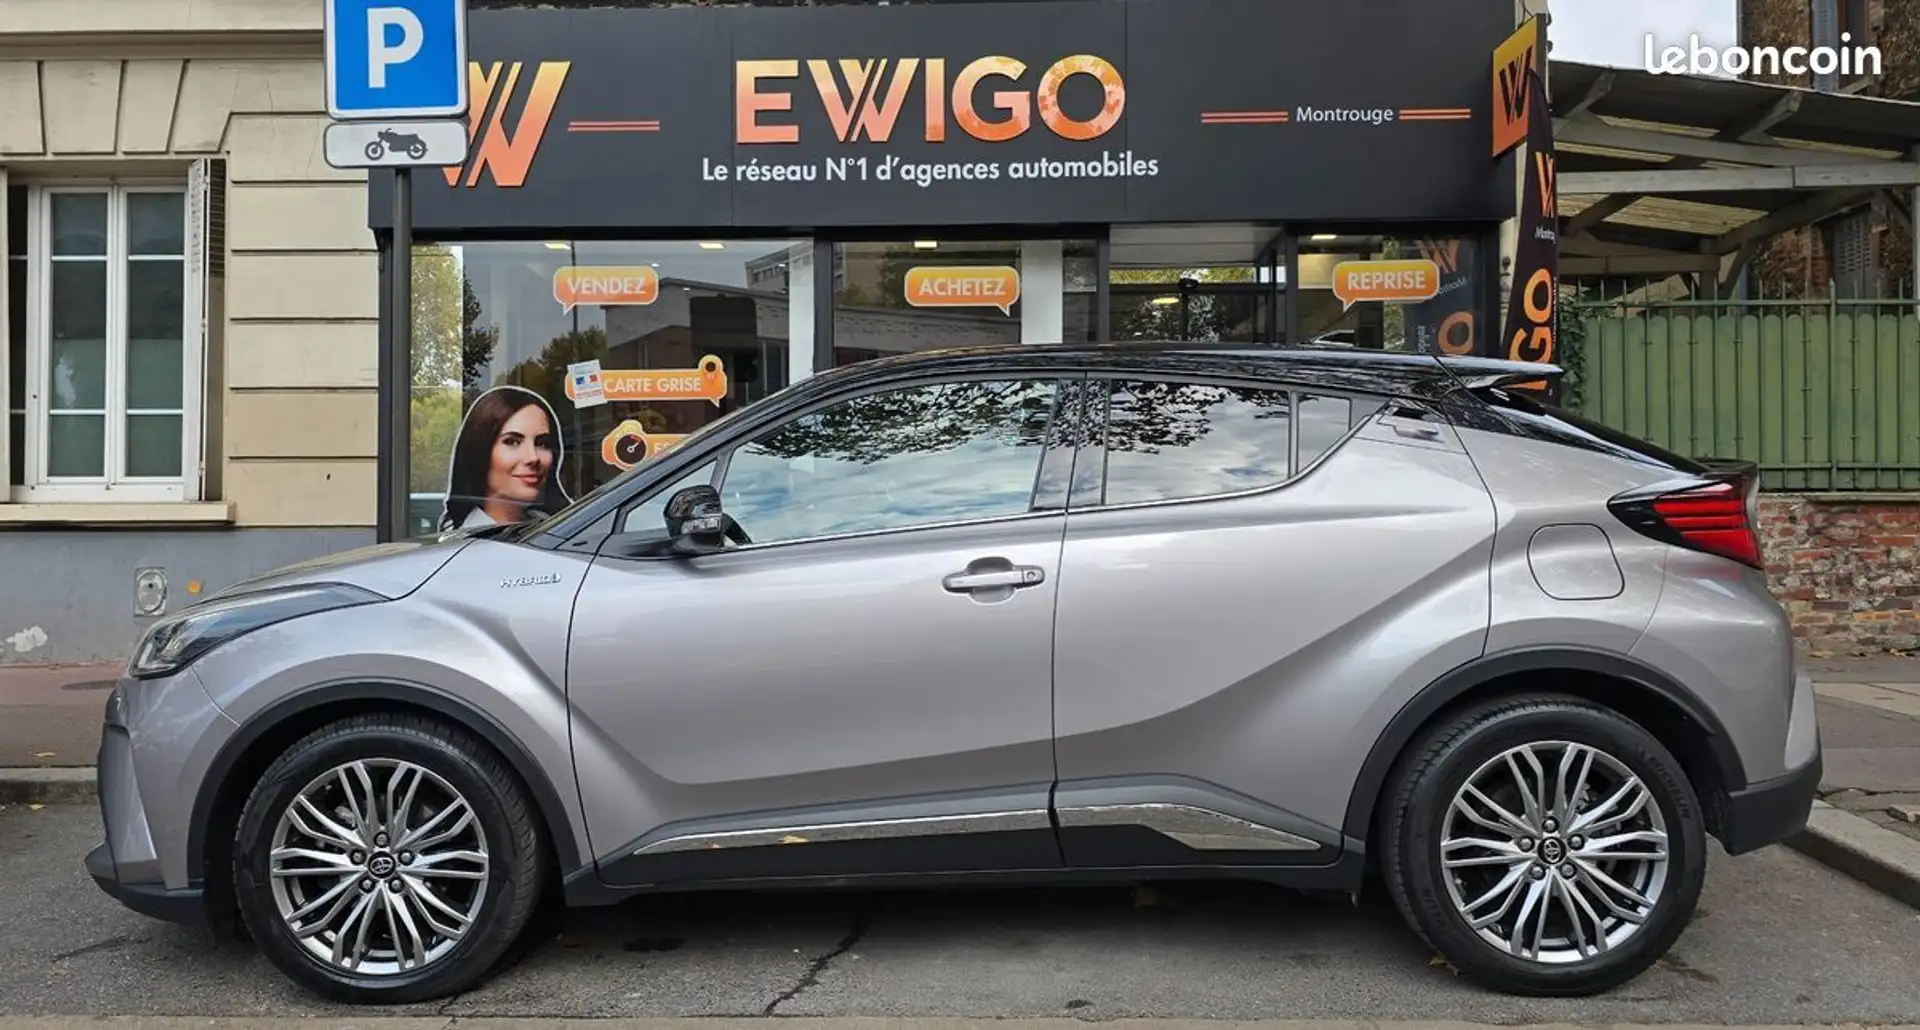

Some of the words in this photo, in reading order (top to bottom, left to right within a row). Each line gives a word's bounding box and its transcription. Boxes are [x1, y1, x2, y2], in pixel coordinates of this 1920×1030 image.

[367, 7, 424, 88] P
[735, 54, 1126, 144] EWIGO
[1296, 106, 1394, 126] Montrouge
[702, 157, 728, 181] Le
[736, 157, 817, 181] réseau
[825, 157, 867, 181] N°1
[875, 154, 1000, 188] d'agences
[1008, 150, 1159, 179] automobiles
[566, 276, 648, 296] VENDEZ
[919, 277, 1006, 296] ACHETEZ
[1347, 270, 1427, 291] REPRISE
[603, 377, 653, 393] CARTE
[656, 376, 702, 393] GRISE
